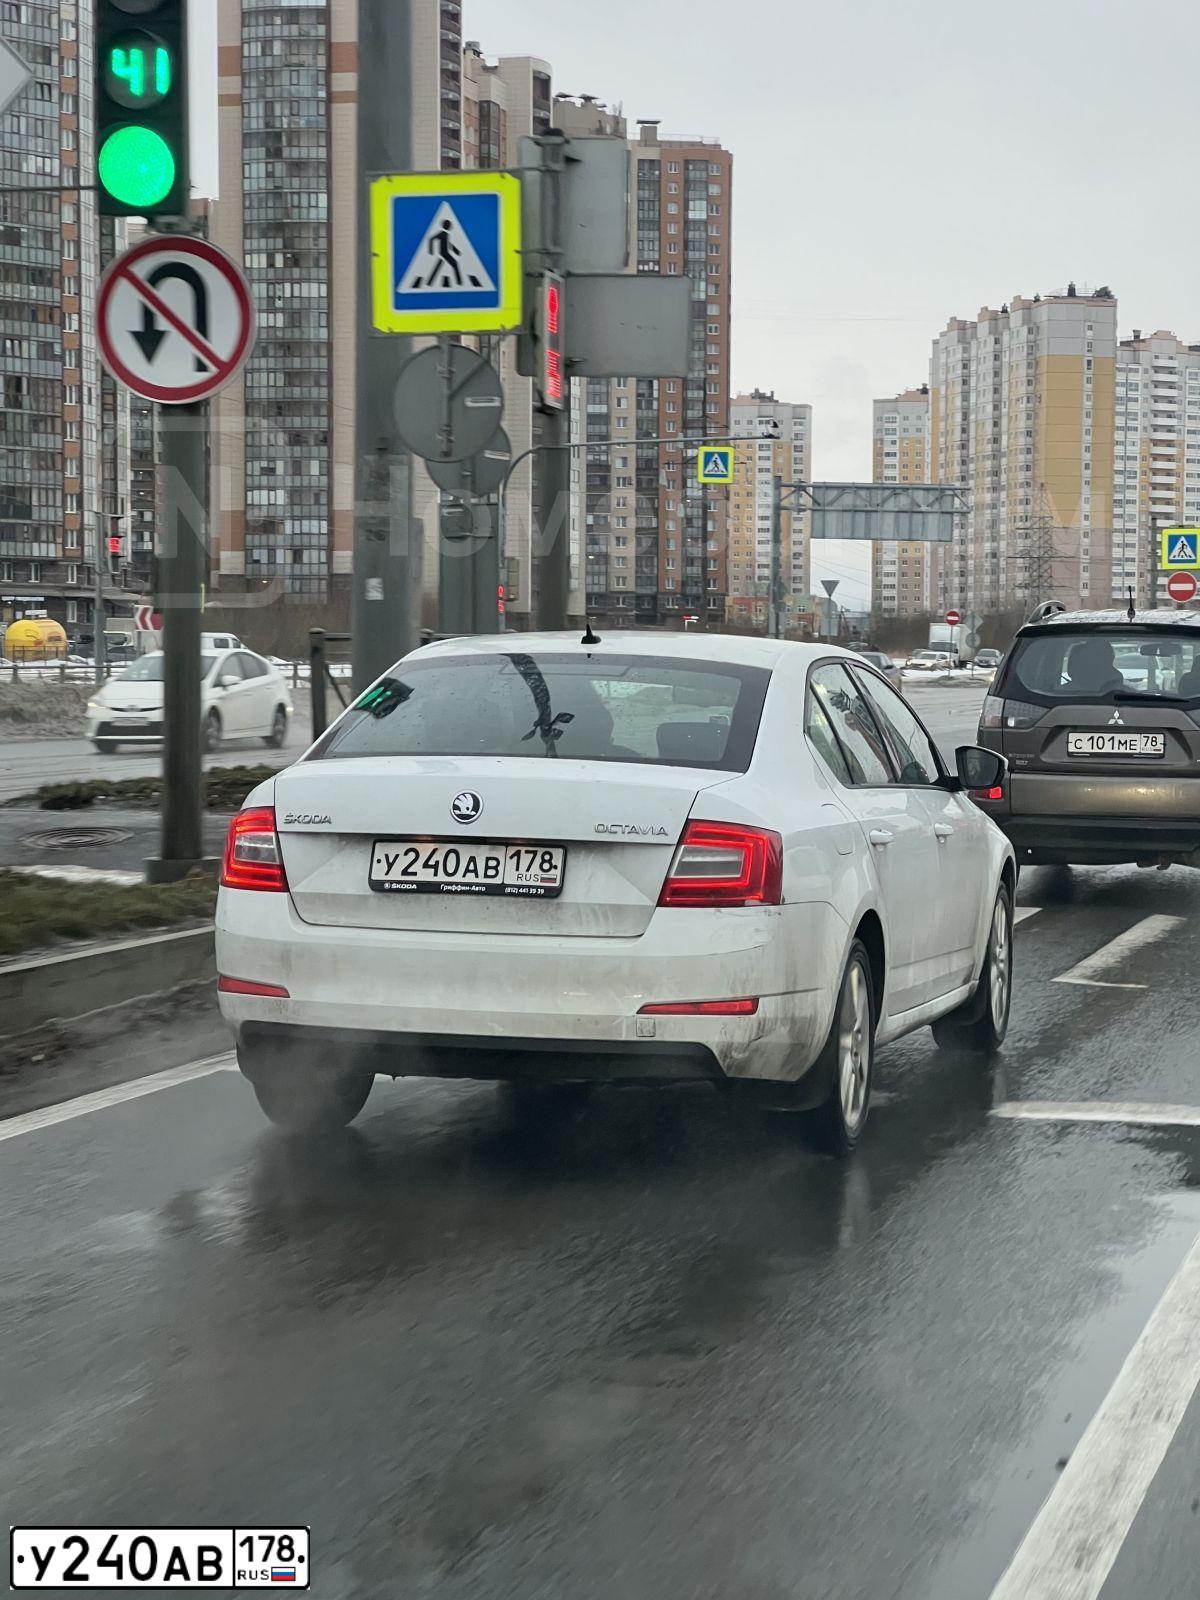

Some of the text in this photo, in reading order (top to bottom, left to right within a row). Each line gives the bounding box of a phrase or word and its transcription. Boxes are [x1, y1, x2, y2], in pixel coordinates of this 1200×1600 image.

[111, 47, 170, 96] 41
[1142, 735, 1158, 747] 78
[594, 823, 669, 836] OCTAVIA
[508, 849, 554, 873] 178
[516, 873, 540, 883] RUS
[440, 884, 486, 892] Гриффин-Авто
